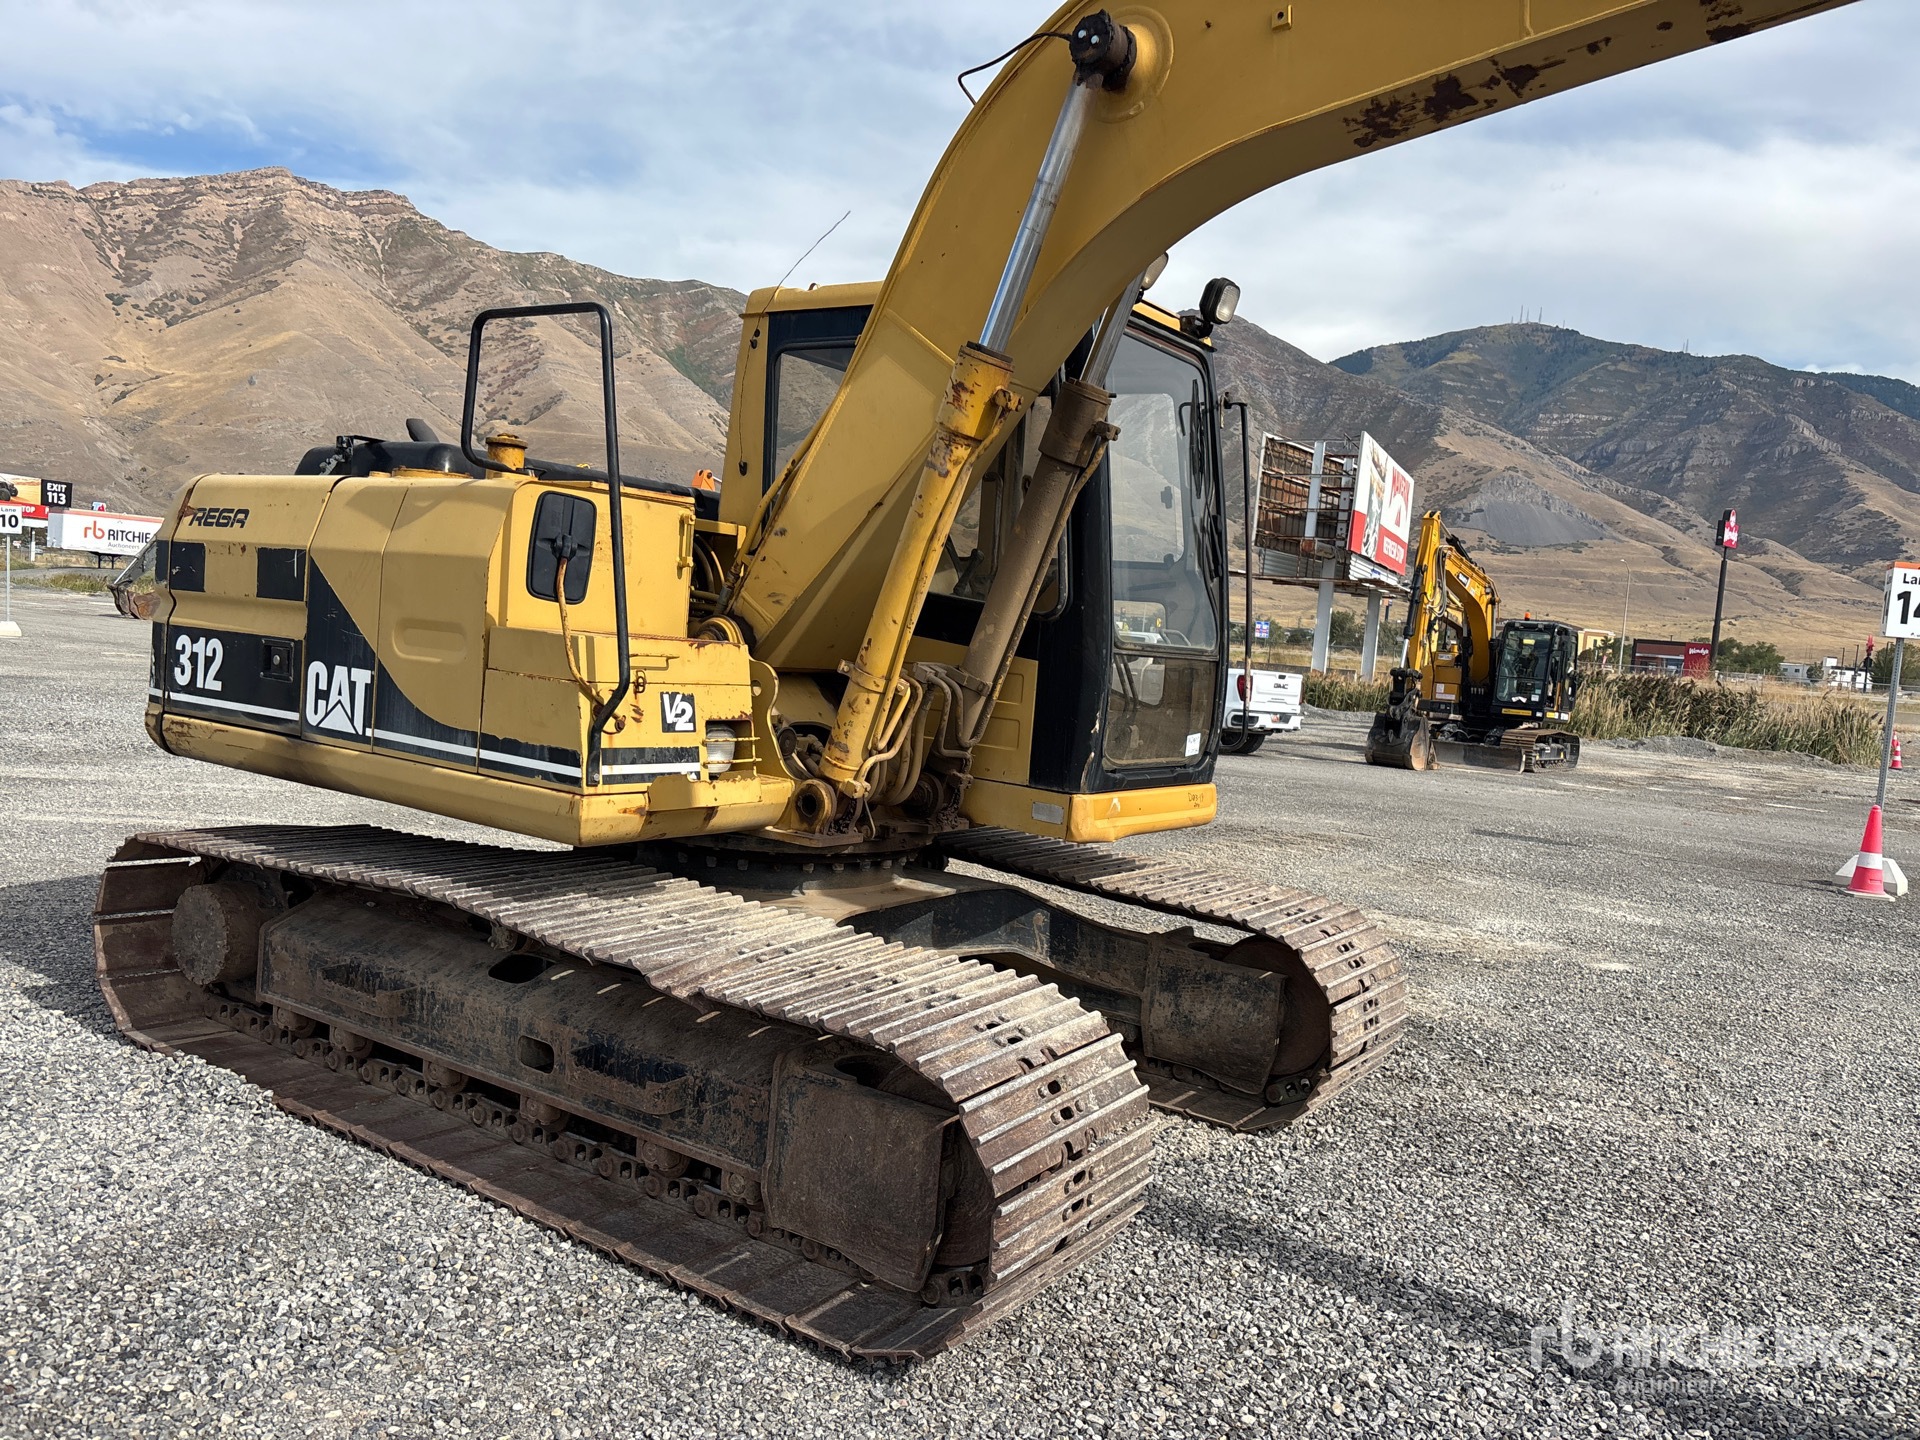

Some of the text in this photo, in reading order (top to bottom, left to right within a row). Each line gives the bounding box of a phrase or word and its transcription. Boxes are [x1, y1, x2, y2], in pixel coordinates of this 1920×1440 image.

[46, 482, 67, 493] EXIT
[46, 492, 66, 505] 113
[0, 514, 19, 528] 10
[107, 529, 151, 544] RITCHIE
[174, 634, 224, 692] 312
[305, 660, 372, 736] CAT
